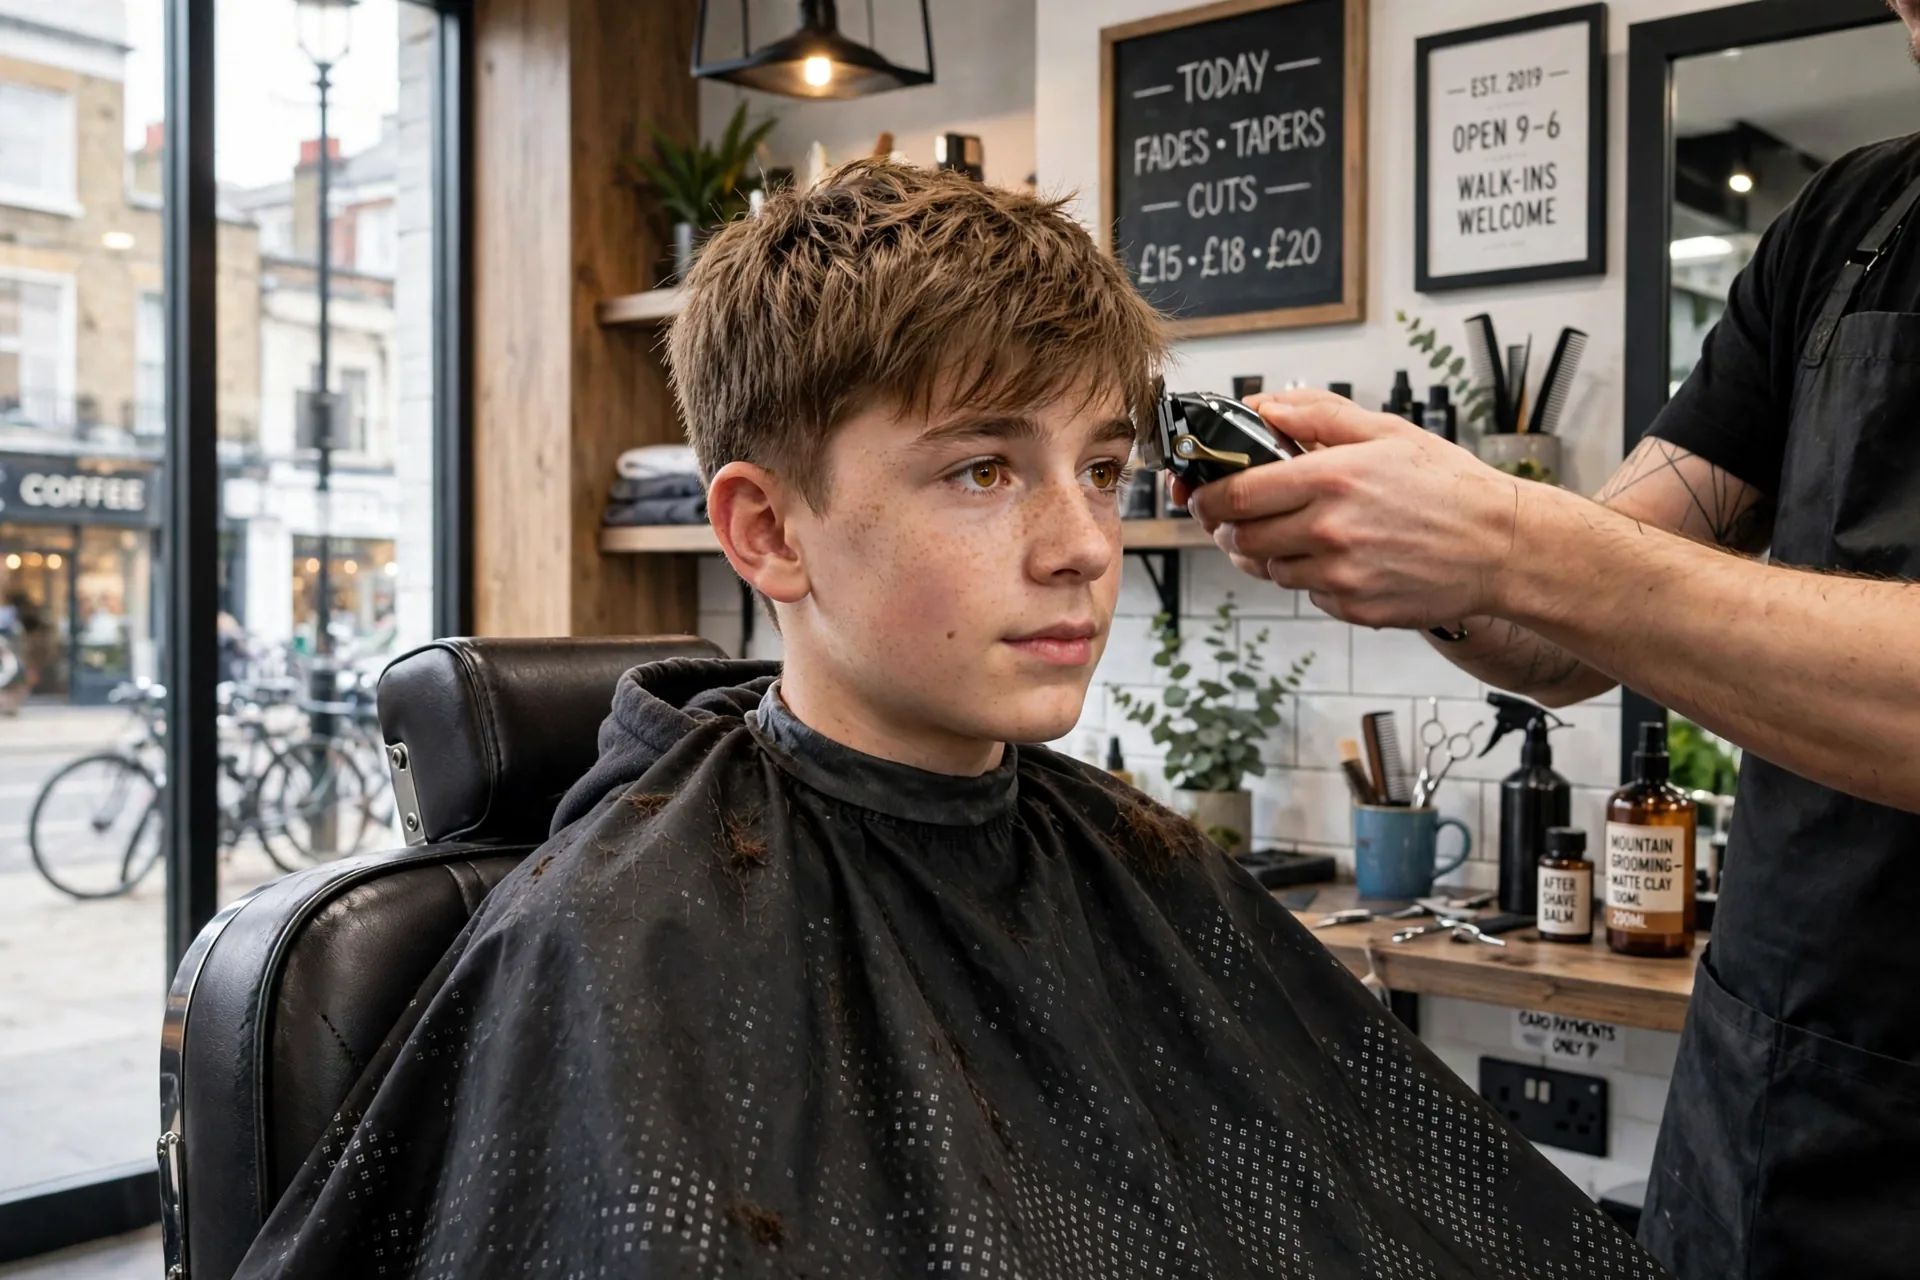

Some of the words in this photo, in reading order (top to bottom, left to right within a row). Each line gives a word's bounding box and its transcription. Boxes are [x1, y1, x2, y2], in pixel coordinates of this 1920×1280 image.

[1176, 48, 1269, 103] TODAY
[1471, 74, 1501, 98] EST.
[1507, 66, 1543, 92] 2019
[1134, 128, 1210, 176] FADES
[1230, 107, 1326, 158] TAPERS
[1453, 118, 1506, 153] OPEN
[1187, 174, 1258, 219] CUTS
[1457, 162, 1557, 200] WALK-INS
[1457, 197, 1556, 236] WELCOME
[1138, 243, 1182, 284] £15
[1200, 235, 1246, 279] £18
[1265, 226, 1321, 270] £20
[20, 472, 145, 511] COFFEE
[1611, 834, 1673, 853] MOUNTAIN
[1544, 876, 1576, 891] AFTER
[1612, 874, 1640, 890] MATTE
[1644, 876, 1672, 891] CLAY
[1544, 908, 1574, 923] BALM
